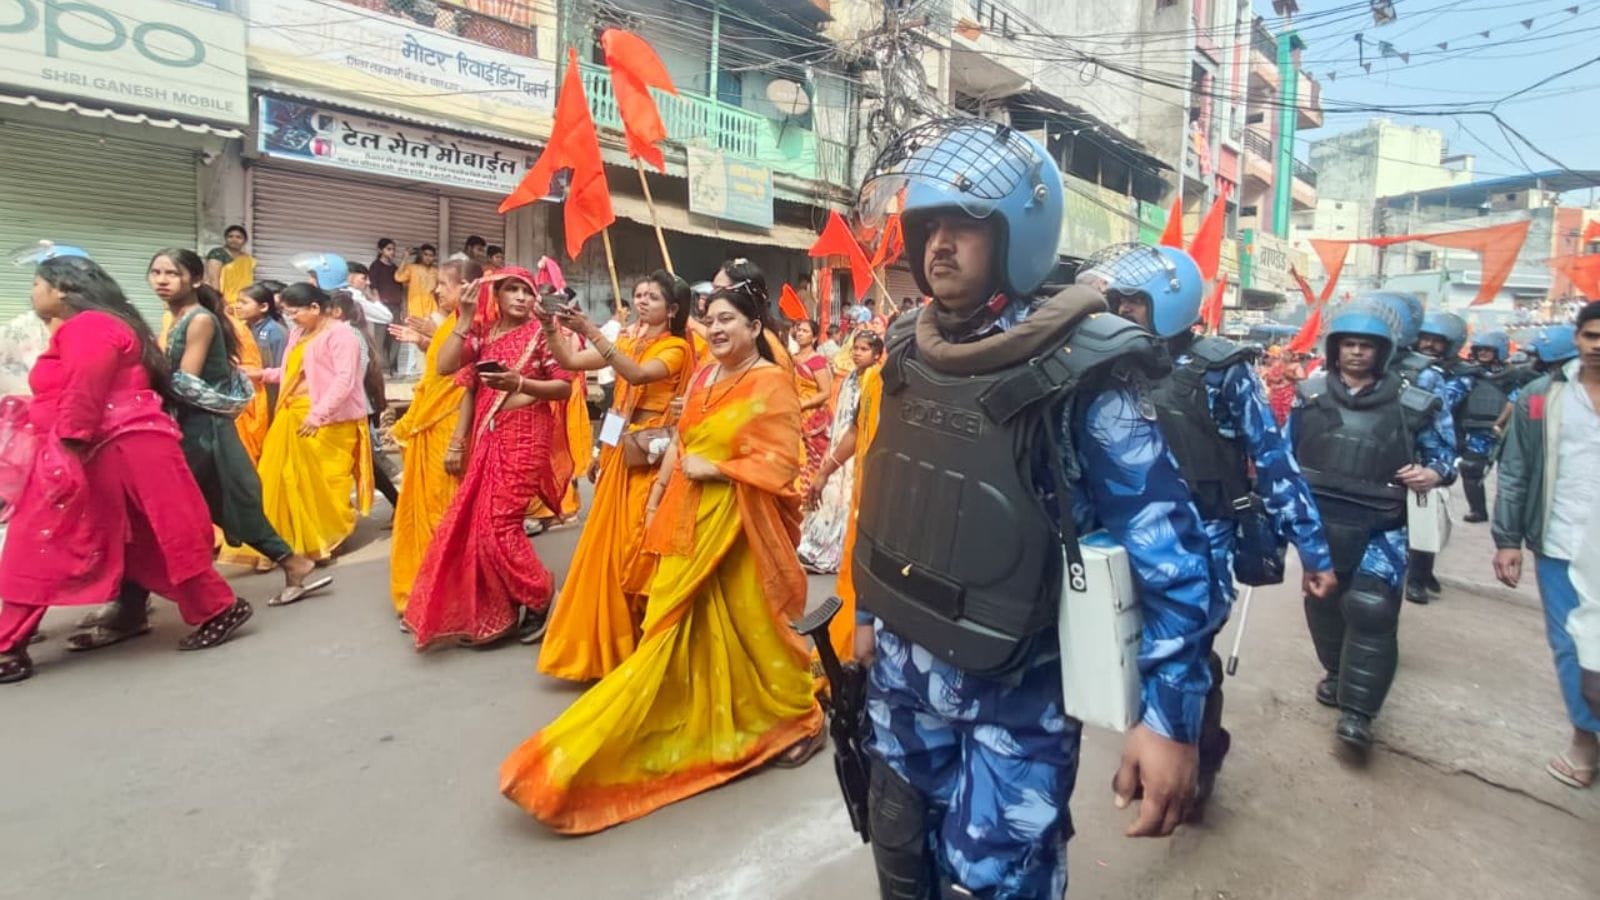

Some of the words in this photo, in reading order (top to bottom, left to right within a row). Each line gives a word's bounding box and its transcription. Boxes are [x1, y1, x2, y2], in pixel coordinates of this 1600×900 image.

[401, 34, 453, 71] मोटर
[41, 68, 88, 86] SHRI
[92, 78, 168, 100] GANESH
[172, 91, 234, 112] MOBILE
[341, 120, 382, 150] टेल
[388, 132, 429, 160] सेल
[435, 143, 517, 175] मोबाईल
